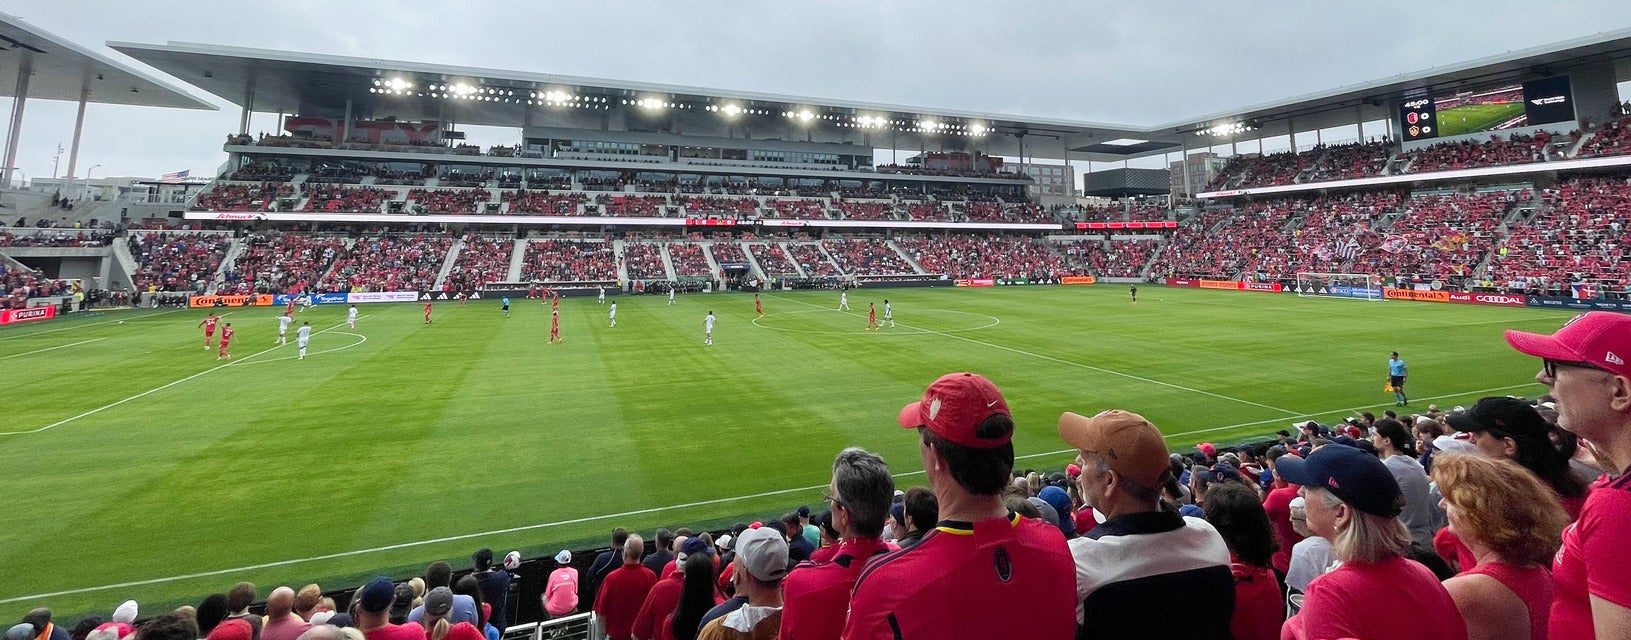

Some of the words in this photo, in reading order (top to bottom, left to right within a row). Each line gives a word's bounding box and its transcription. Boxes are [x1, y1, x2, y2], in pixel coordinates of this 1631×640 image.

[1404, 99, 1429, 107] 45:00
[1420, 112, 1430, 120] 0
[1422, 126, 1431, 134] 0
[1387, 289, 1437, 299] Continental
[18, 309, 45, 319] PURINA
